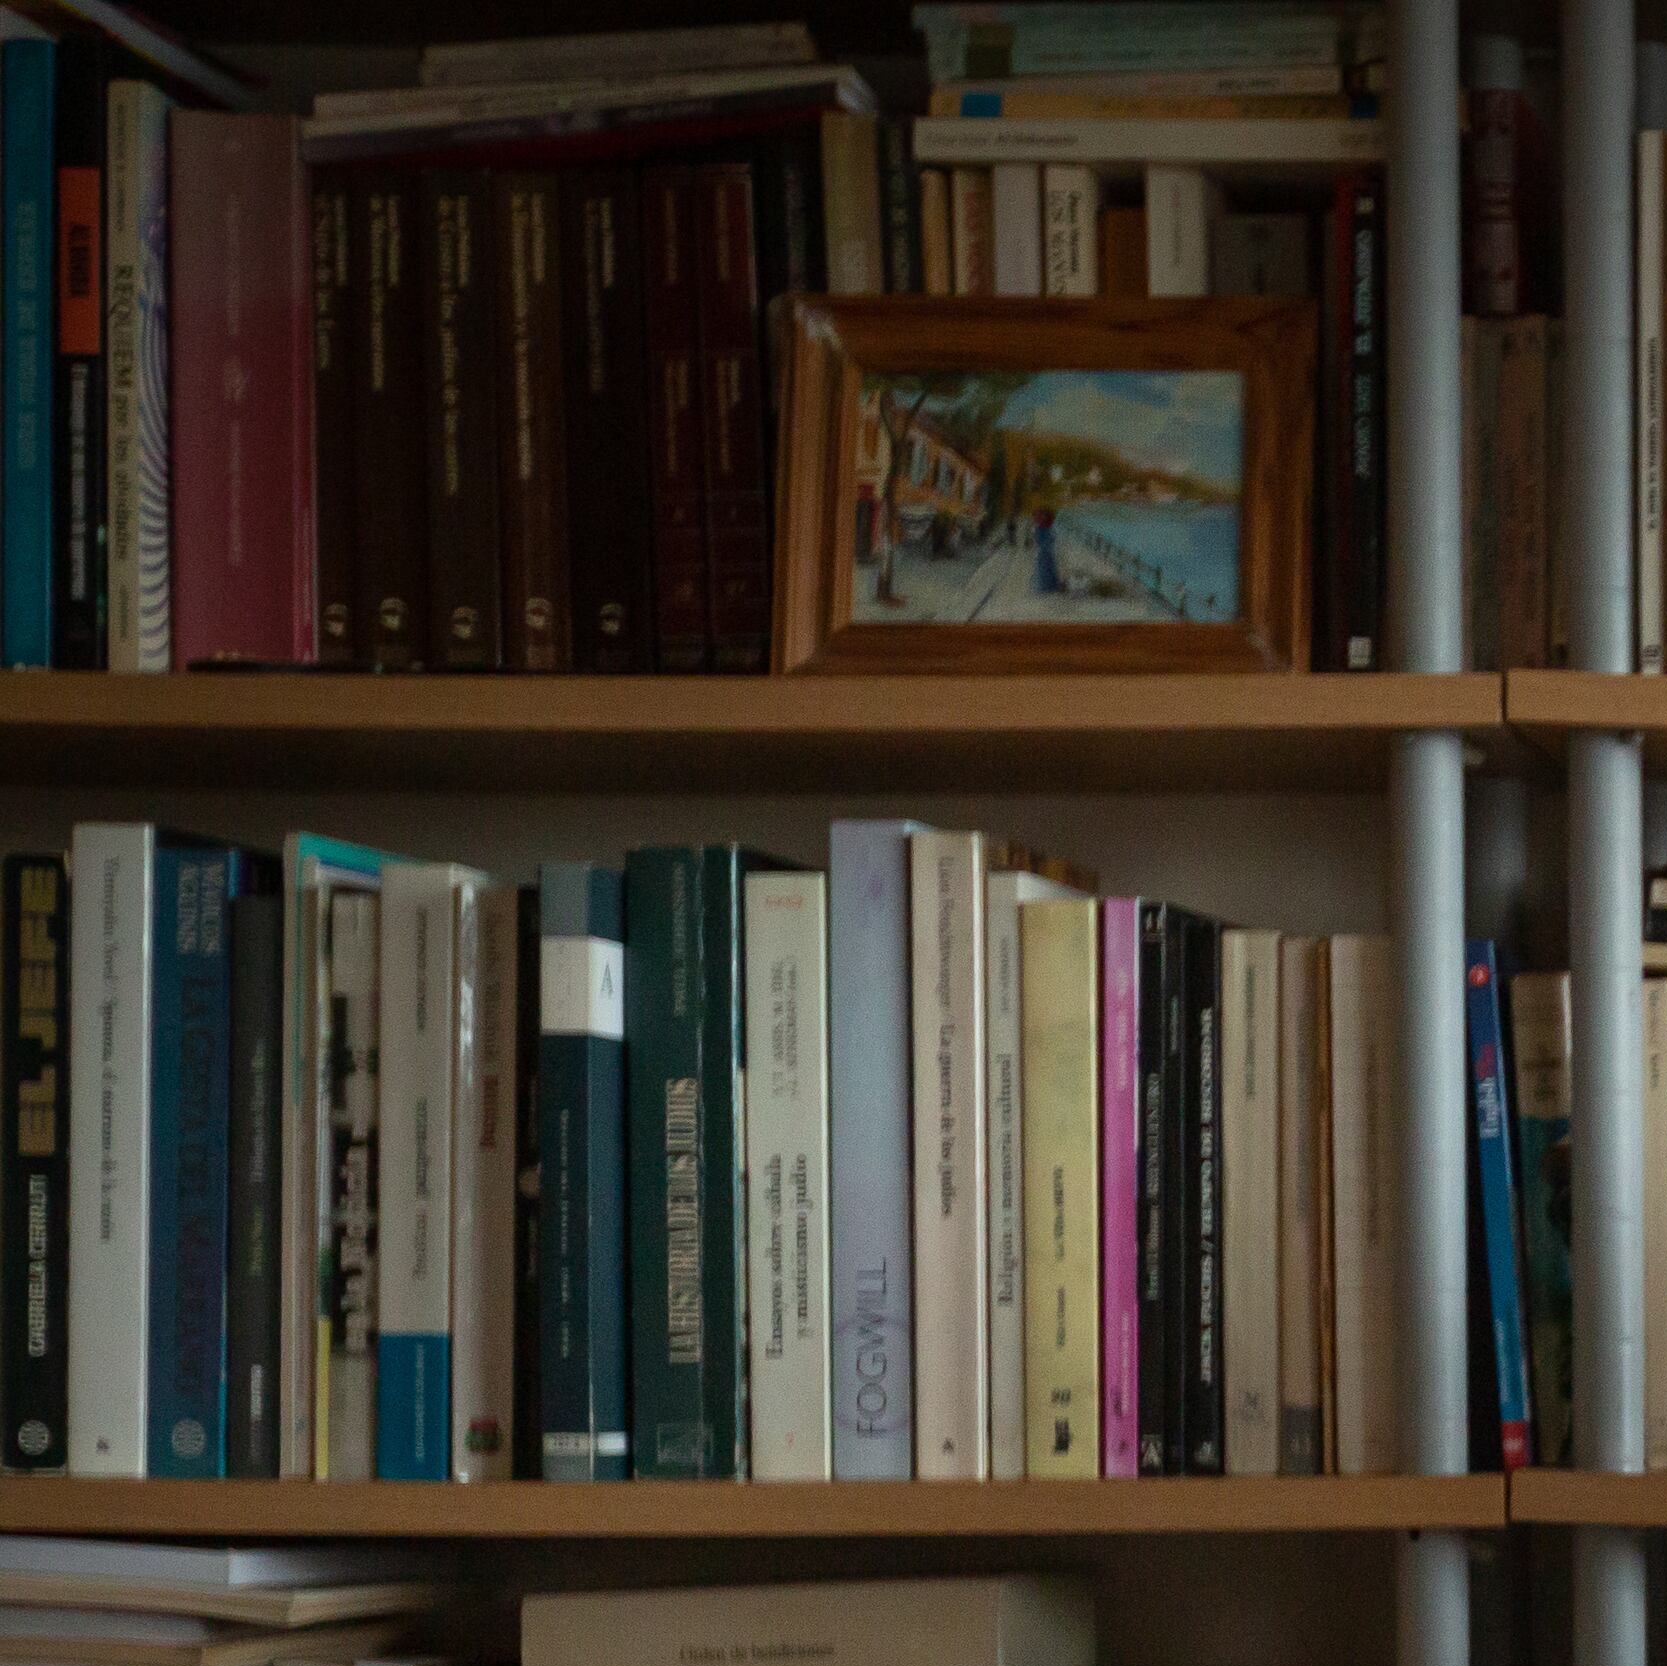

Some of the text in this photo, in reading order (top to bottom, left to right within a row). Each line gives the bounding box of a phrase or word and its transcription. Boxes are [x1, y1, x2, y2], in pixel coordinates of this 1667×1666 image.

[21, 868, 56, 1155] EL JEFE
[855, 1256, 887, 1440] FOGWILL
